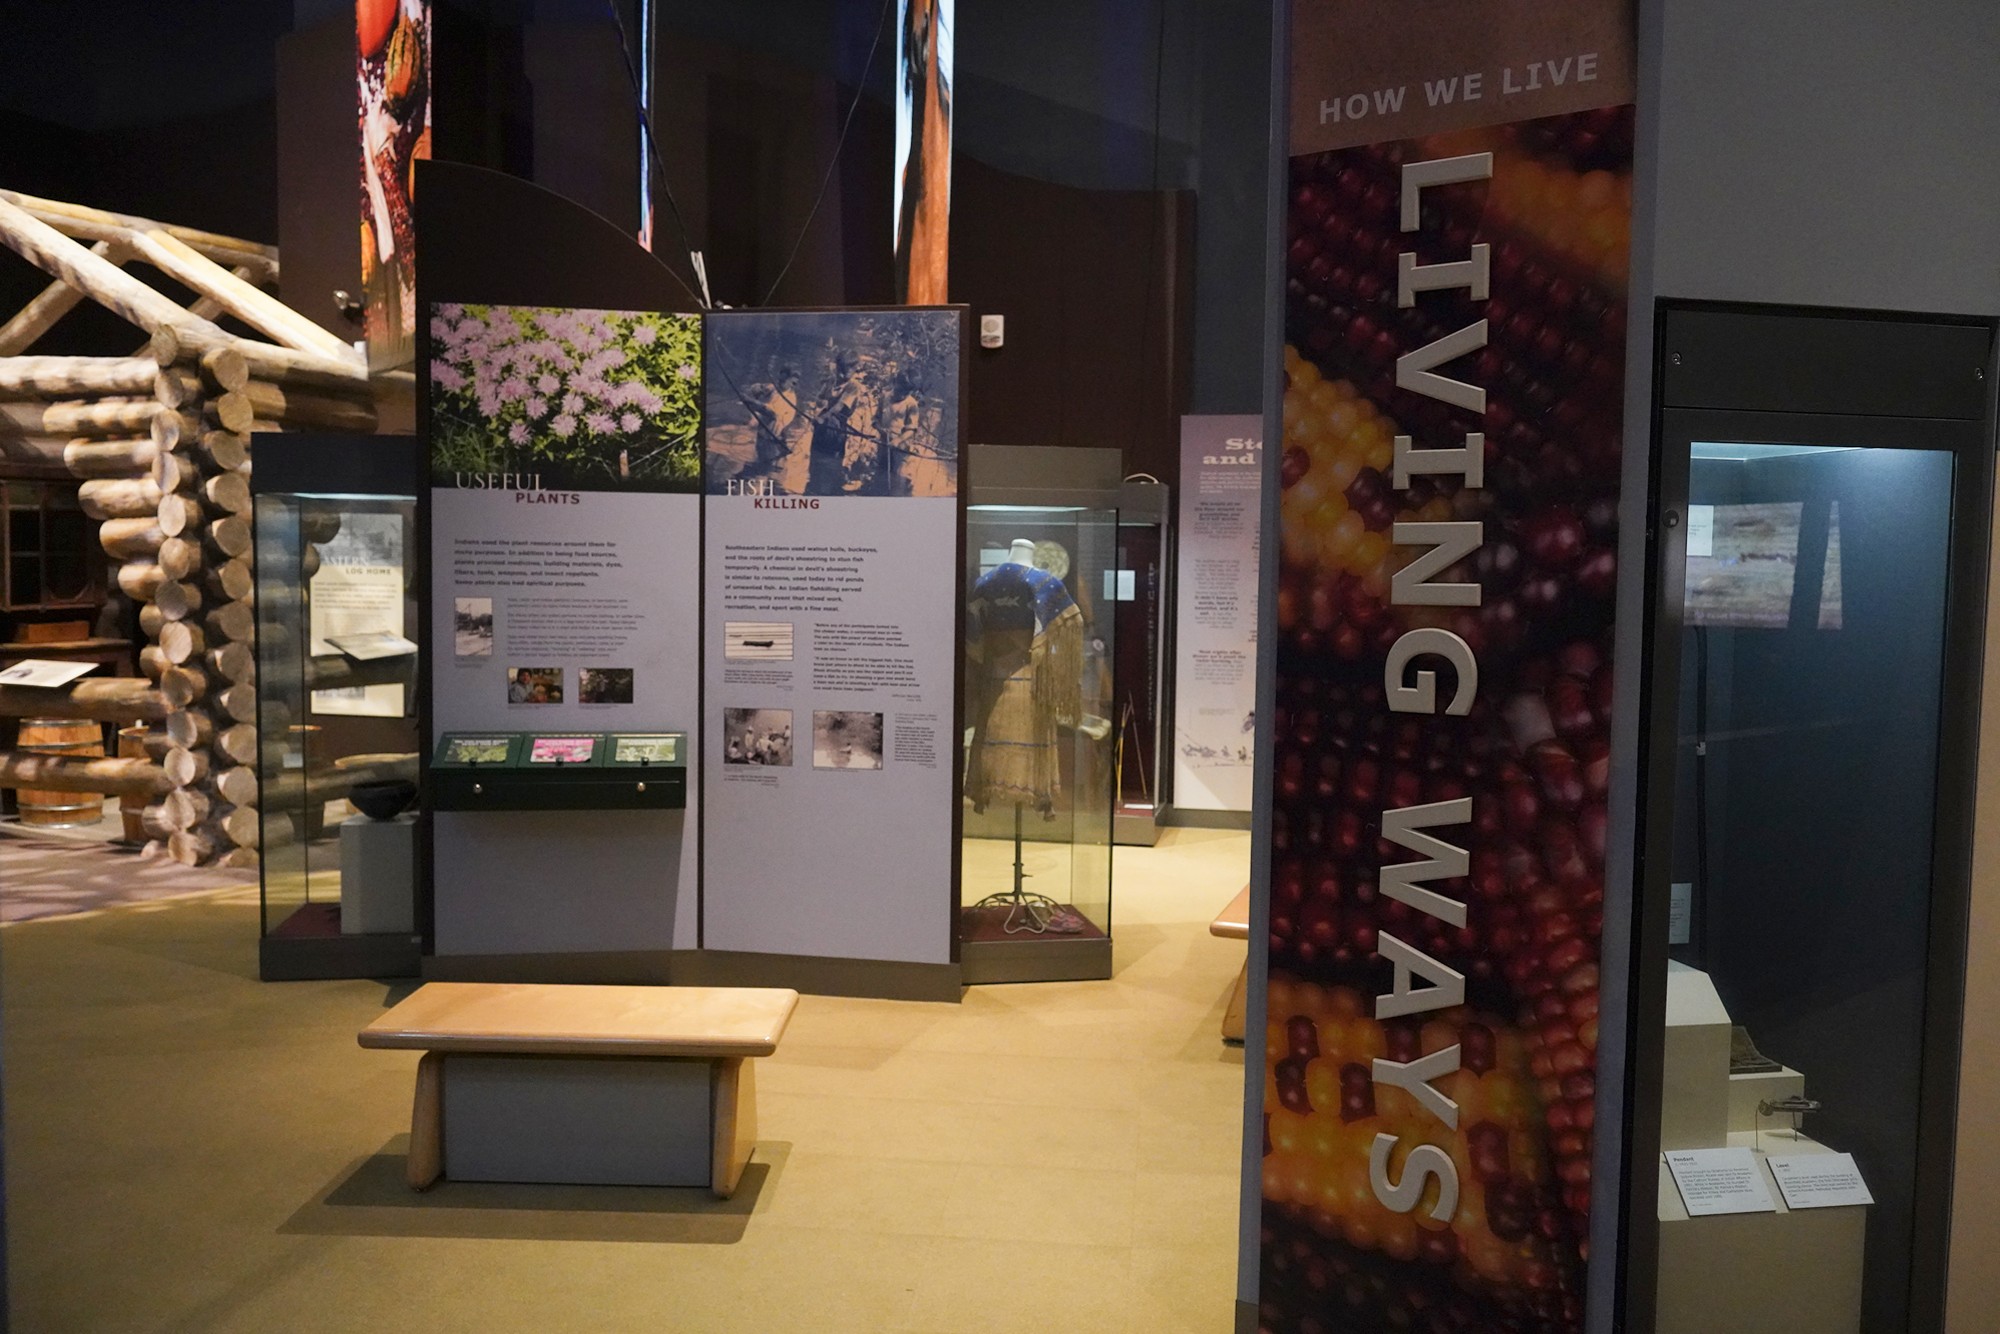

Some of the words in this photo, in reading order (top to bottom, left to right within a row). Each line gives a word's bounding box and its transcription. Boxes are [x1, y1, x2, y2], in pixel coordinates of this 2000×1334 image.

[1319, 86, 1406, 124] HOW
[1424, 73, 1482, 107] WE
[1502, 53, 1598, 94] LIVE
[1384, 151, 1493, 716] LIVING
[1203, 453, 1256, 465] and
[456, 472, 547, 491] USEFUL
[727, 479, 774, 496] FISH
[515, 492, 580, 504] PLANTS
[754, 498, 820, 509] KILLING
[809, 574, 825, 583] today
[845, 575, 864, 583] ponds
[826, 594, 843, 603] work,
[772, 603, 787, 612] sport
[1369, 797, 1473, 1223] WAYS
